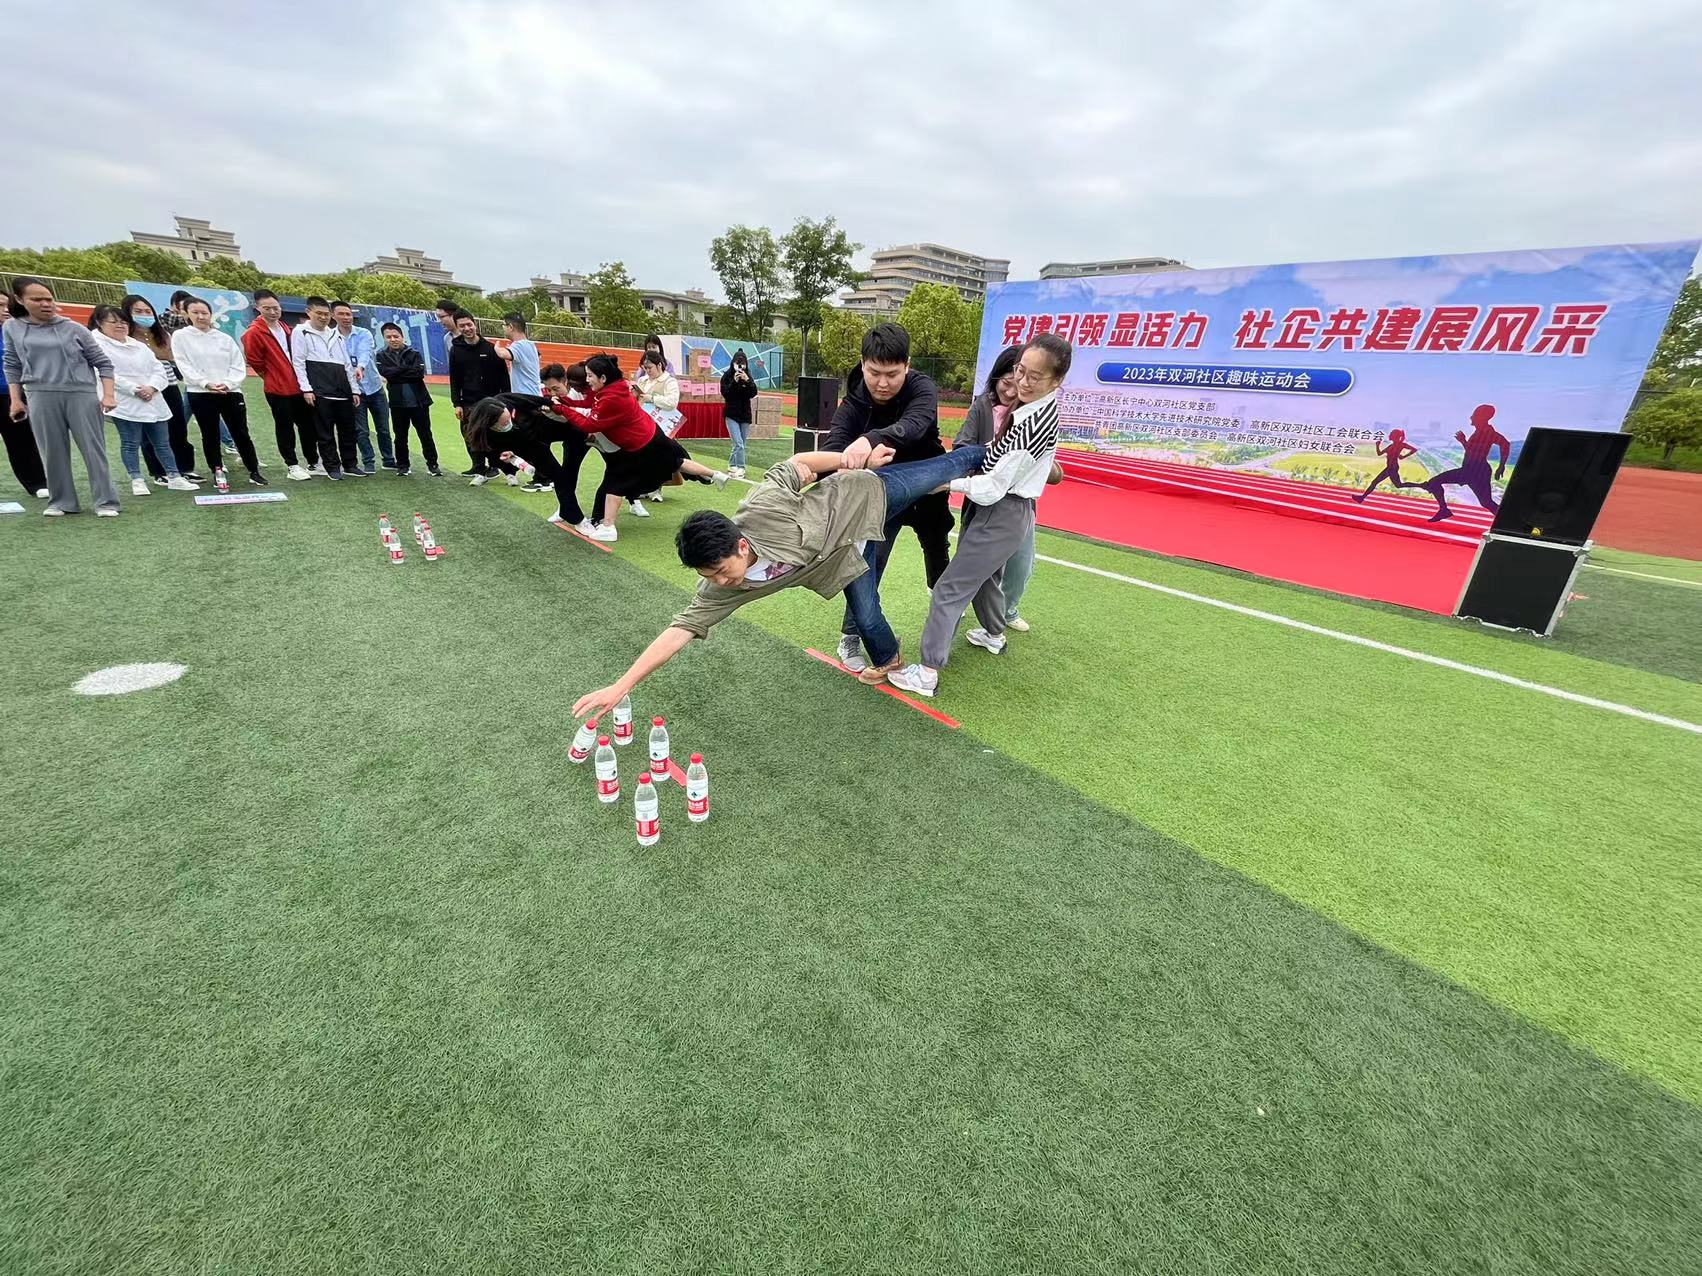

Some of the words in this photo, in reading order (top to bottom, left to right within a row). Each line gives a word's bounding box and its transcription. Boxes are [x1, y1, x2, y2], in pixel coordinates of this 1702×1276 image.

[1235, 304, 1607, 354] 社企共建展风采
[1122, 367, 1310, 390] 2023年双河社区趣味运动会
[1250, 420, 1385, 441] 高新区双河社区工会联合会
[1226, 433, 1355, 455] 高新区双河社区妇女联合会
